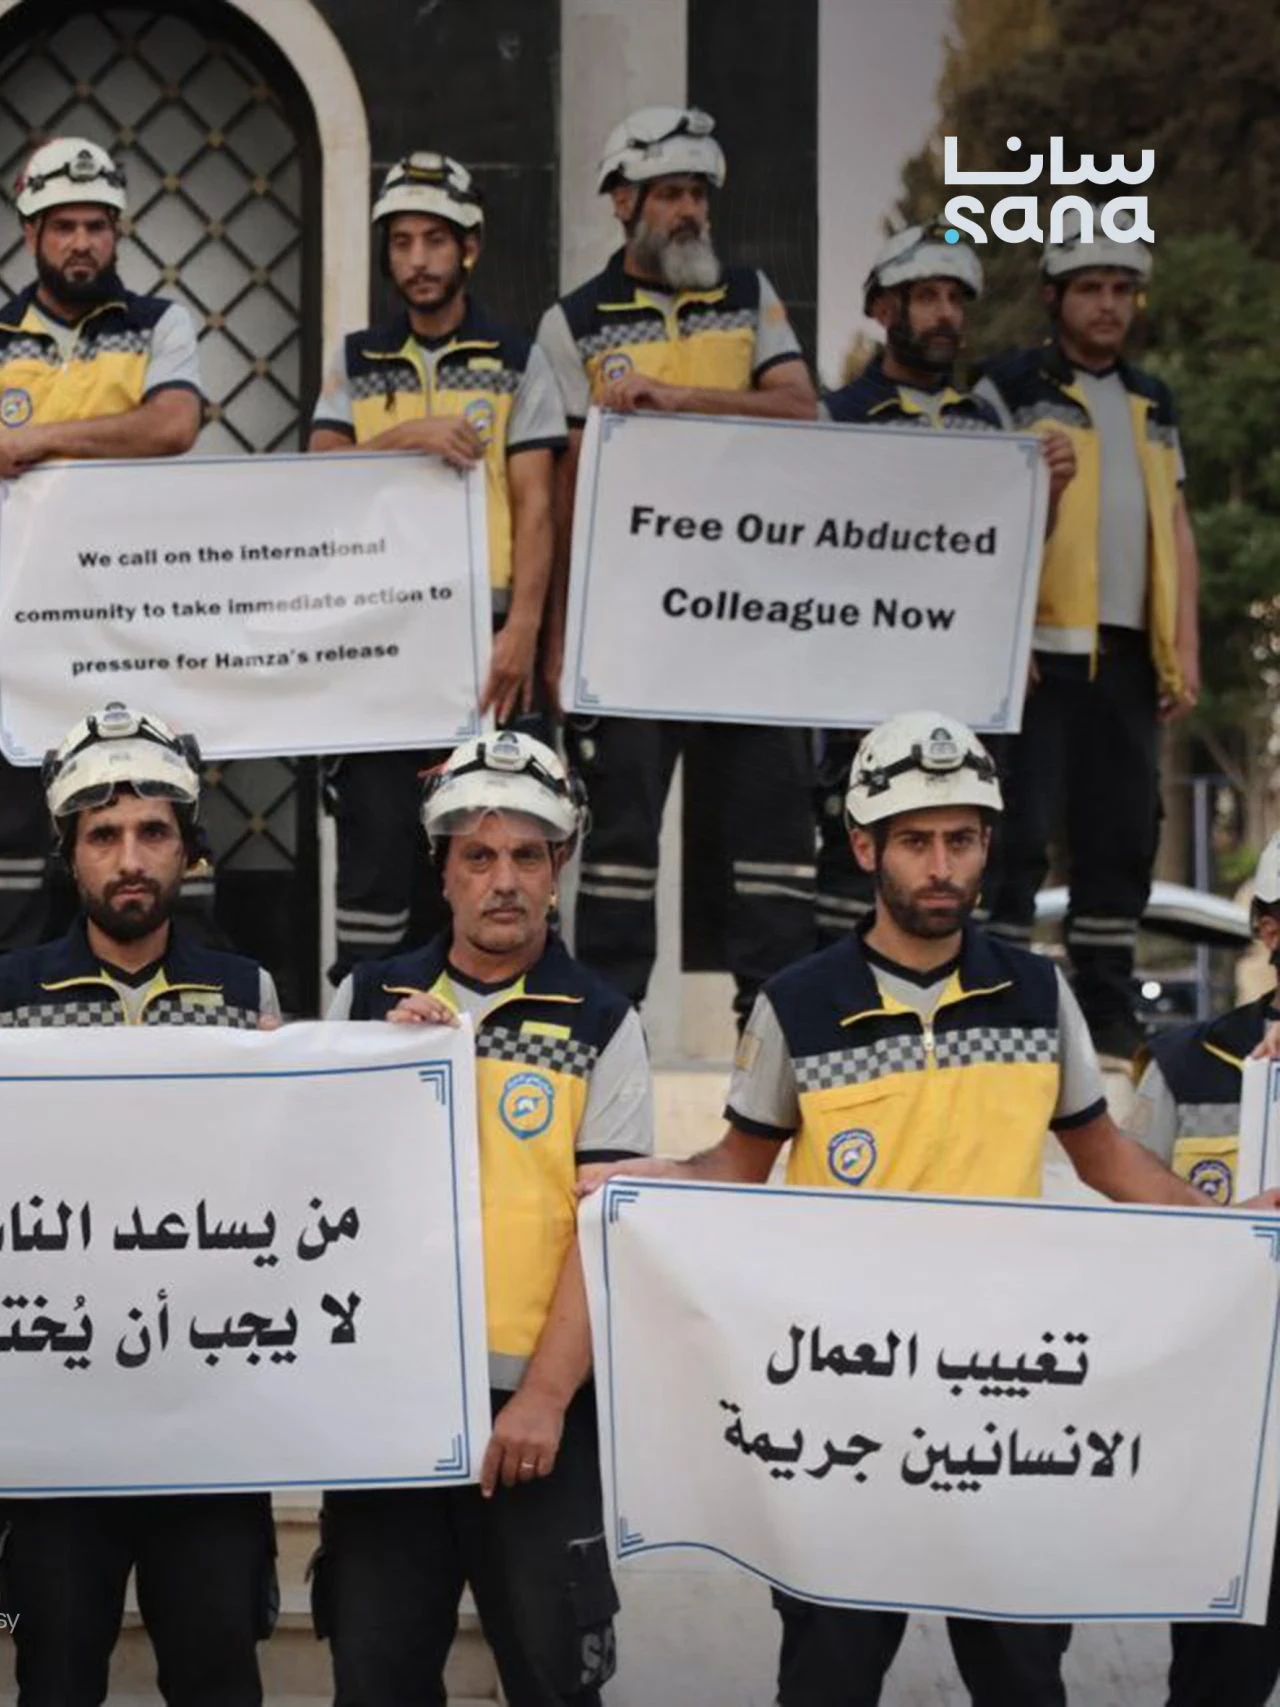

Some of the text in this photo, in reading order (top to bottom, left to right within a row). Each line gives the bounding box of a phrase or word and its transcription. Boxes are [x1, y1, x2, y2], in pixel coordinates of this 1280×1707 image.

[77, 538, 386, 568] We call on the international
[629, 504, 998, 556] Free Our Abducted
[13, 585, 454, 624] community to take immediate action to
[661, 586, 957, 633] Colleague Now
[71, 656, 172, 678] pressure
[175, 652, 209, 670] for
[314, 643, 400, 663] release
[112, 1198, 280, 1269] يساعد
[295, 1196, 361, 1263] من
[114, 1287, 170, 1370] أن
[188, 1306, 299, 1368] يجب
[319, 1290, 363, 1346] لا
[765, 1324, 1090, 1400] تغييب العمال
[718, 1398, 1142, 1494] الانسانيين جريمة
